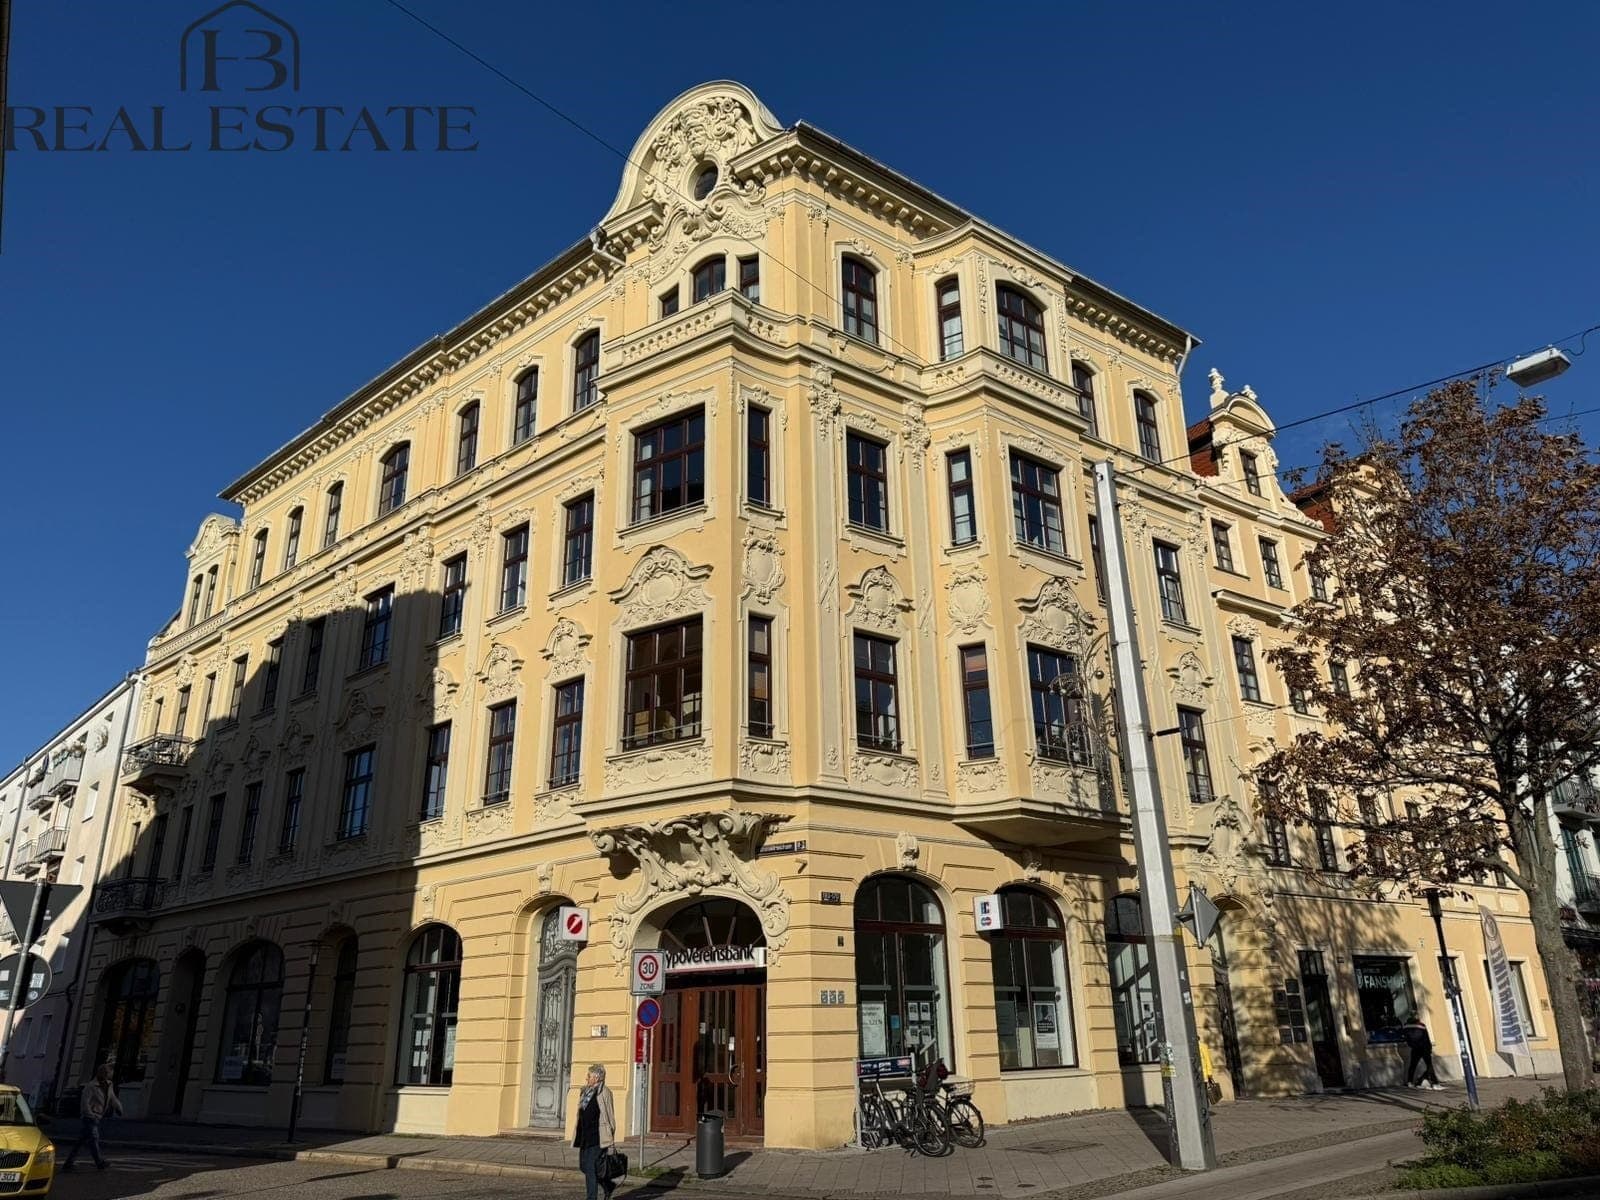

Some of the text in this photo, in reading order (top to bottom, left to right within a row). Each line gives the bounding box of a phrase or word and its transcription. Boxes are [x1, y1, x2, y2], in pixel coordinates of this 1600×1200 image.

[665, 944, 755, 968] ypoVereinsbank
[642, 961, 655, 975] 30
[640, 982, 656, 990] ZONE
